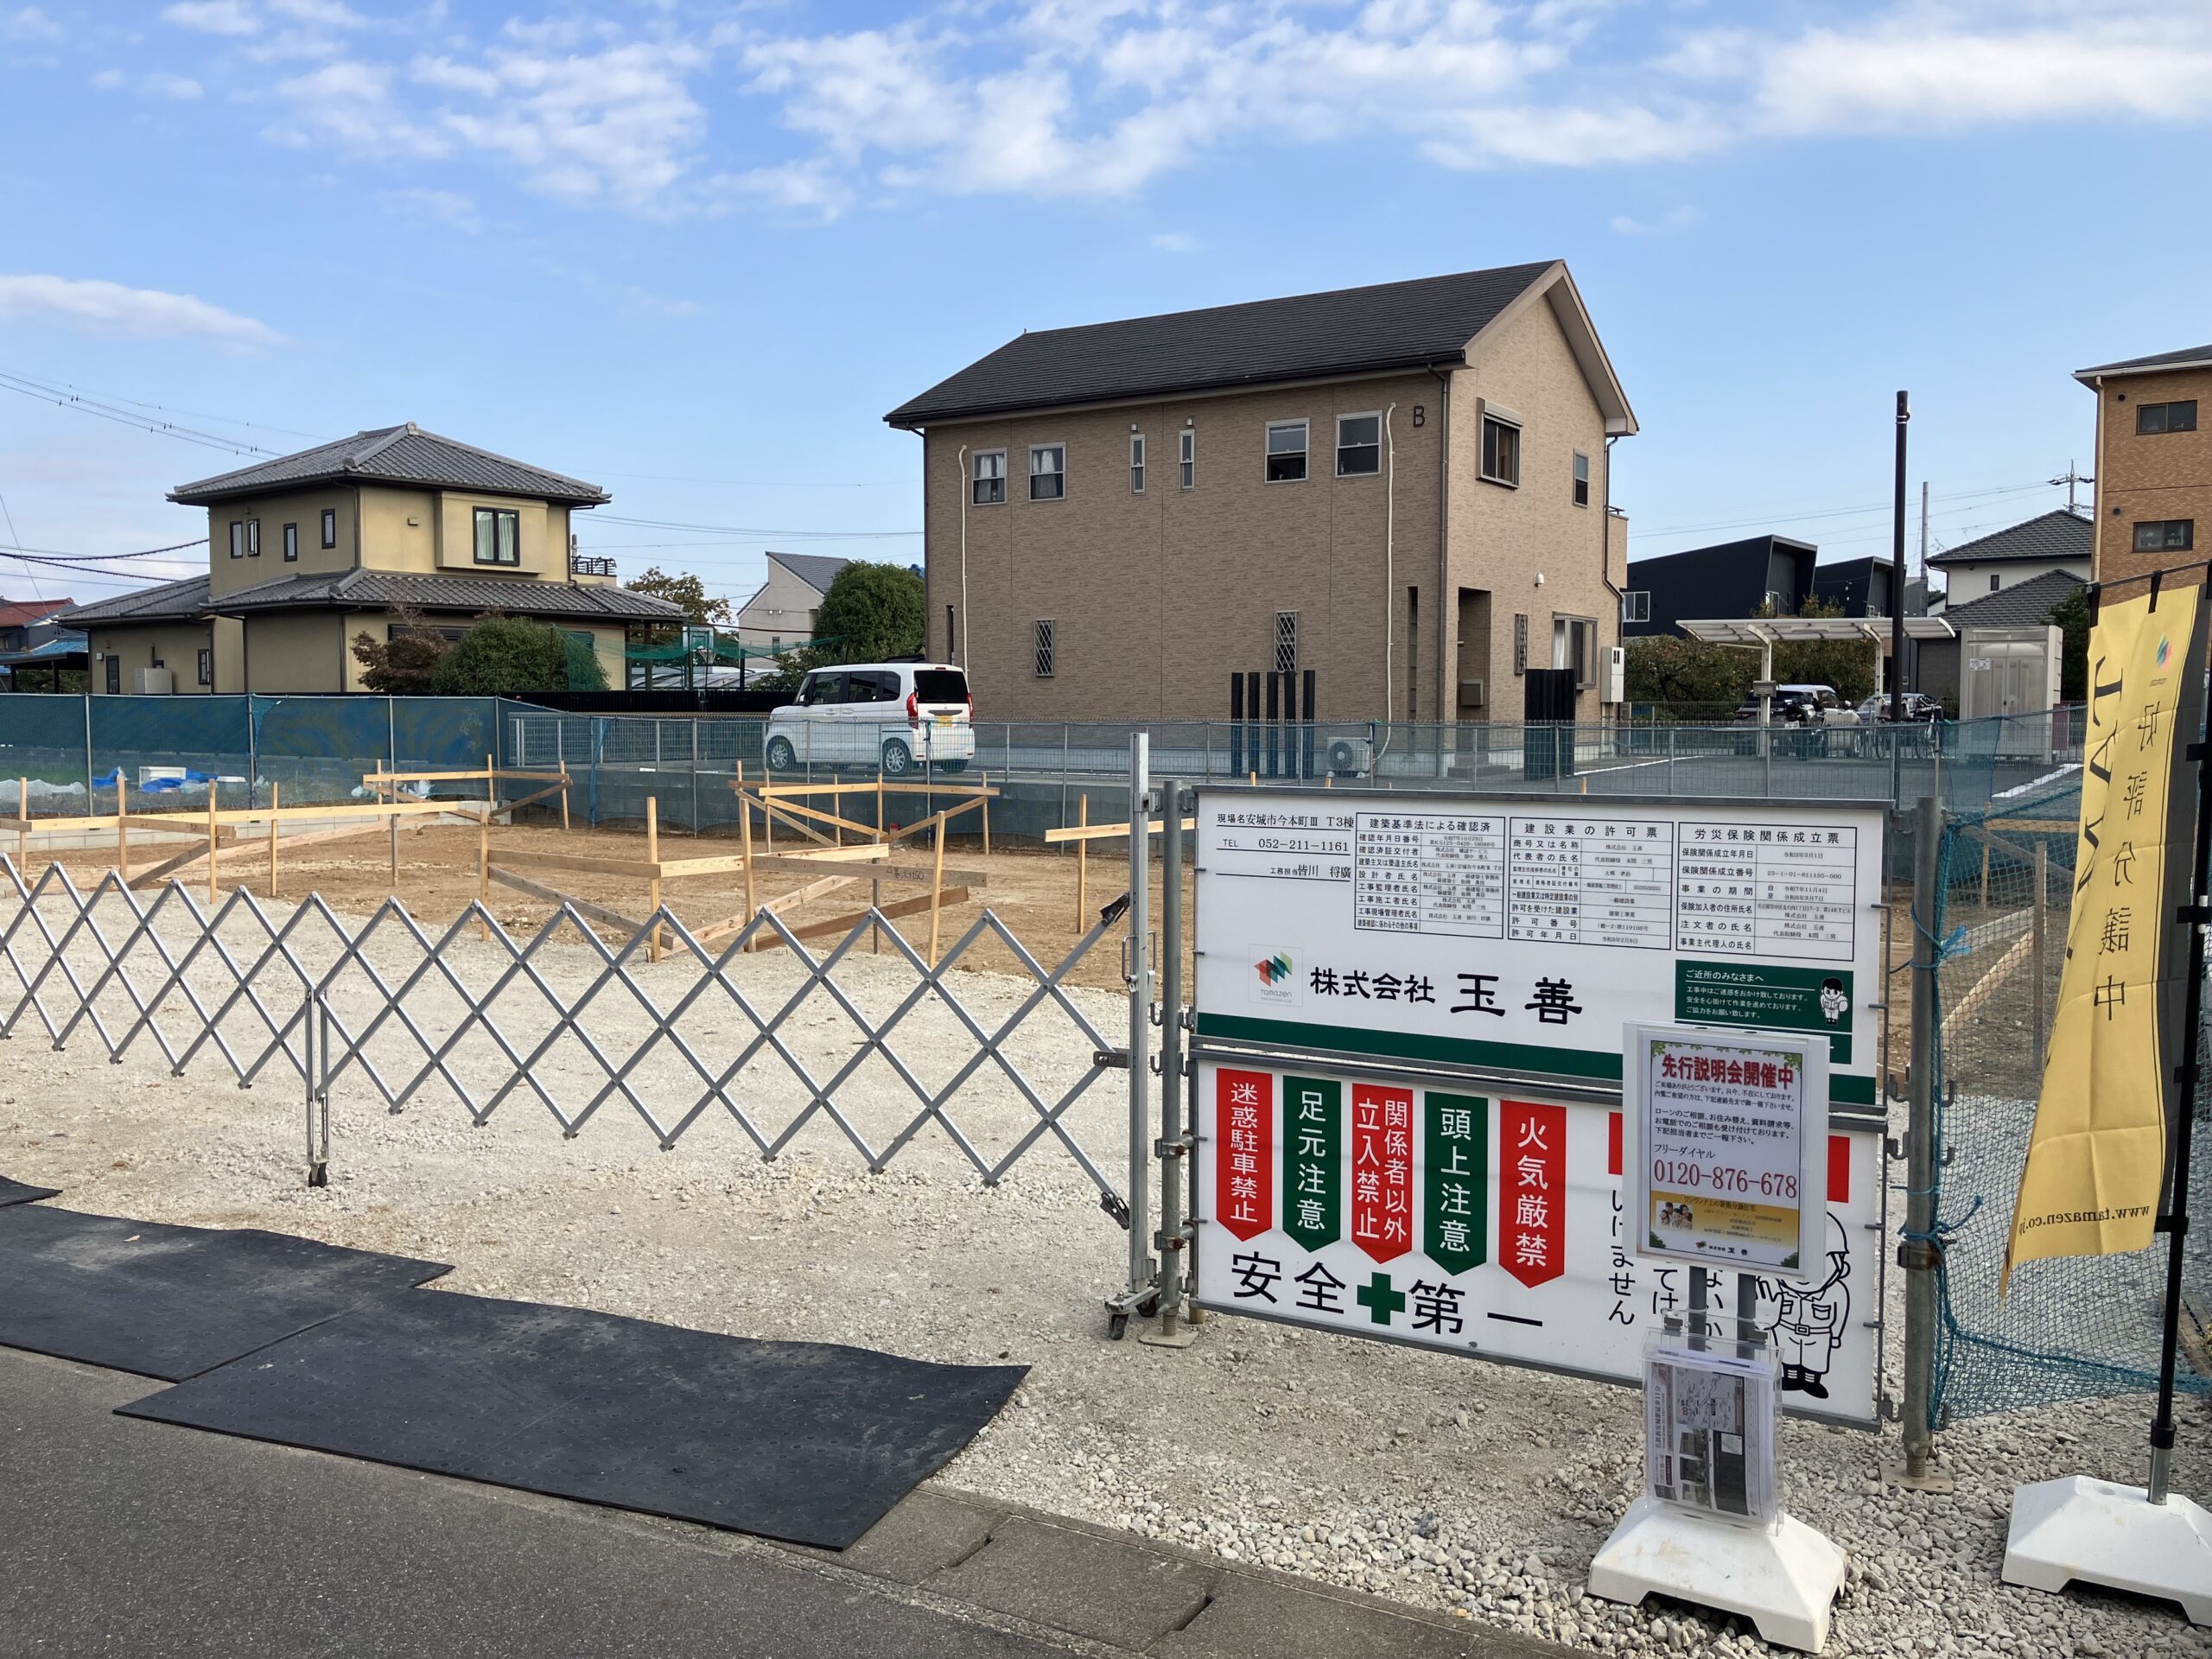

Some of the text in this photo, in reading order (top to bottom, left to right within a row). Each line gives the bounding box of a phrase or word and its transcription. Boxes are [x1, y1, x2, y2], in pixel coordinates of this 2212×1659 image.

[1413, 405, 1426, 428] B
[1369, 817, 1491, 833] 建築基準法による確認済
[1524, 823, 1658, 838] 建設業の許可票
[1358, 834, 1420, 844] 確認年月日番号
[1694, 828, 1840, 844] 労災保険関係成立票
[1223, 838, 1349, 851] TEL 052-211-1161
[1358, 846, 1420, 856] 確認済証交付者
[1513, 839, 1580, 850] 商号又は名称
[1513, 852, 1579, 863] 代表者の氏名
[1681, 848, 1753, 858] 保険関係成立年月日
[1358, 857, 1419, 868] 建築主又は築造主氏名
[1358, 871, 1418, 881] 設計者氏名
[1681, 866, 1753, 877] 保険関係成立番号
[1358, 883, 1418, 893] 工事監理者氏名
[1681, 885, 1753, 897] 事業の期間
[1358, 895, 1418, 906] 工事施工者氏名
[1512, 892, 1579, 901] 一般建設業又は特定建設業の別
[1358, 908, 1418, 918] 工事現場管理者氏名
[1512, 904, 1578, 914] 許可を受けた建設業
[1681, 902, 1753, 914] 保険加入者の住所氏名
[1512, 916, 1578, 929] 許可番号
[1681, 920, 1751, 932] 注文者の氏名
[1512, 929, 1577, 940] 許可年月日
[1680, 938, 1751, 950] 事業主代理人の氏名
[1686, 969, 1764, 983] ご近所のみなさまへ
[1310, 966, 1436, 1004] 株式会社
[1686, 986, 1808, 1002] 工事中はご迷惑をおかけ致しております。
[1686, 995, 1802, 1012] 安全を心掛けて作業を進めております。
[1686, 1006, 1761, 1020] ご協力をお願い致します。
[1661, 1053, 1795, 1090] 先行説明会開催中
[1655, 1117, 1789, 1139] お電話でのご相談も受け付けております。
[1656, 1127, 1754, 1145] 下記担当者までご一報下さい。
[1230, 1082, 1258, 1223] 迷惑駐車禁止
[1654, 1144, 1716, 1160] フリーダイヤル
[1297, 1090, 1326, 1230] 足元注意
[1356, 1097, 1381, 1239] 立入禁止
[1383, 1099, 1408, 1243] 関係者以外
[1439, 1108, 1471, 1252] 頭上注意
[1654, 1160, 1797, 1198] 0120-876-678
[1515, 1116, 1548, 1267] 火気厳禁
[1231, 1251, 1543, 1335] 安全 第一
